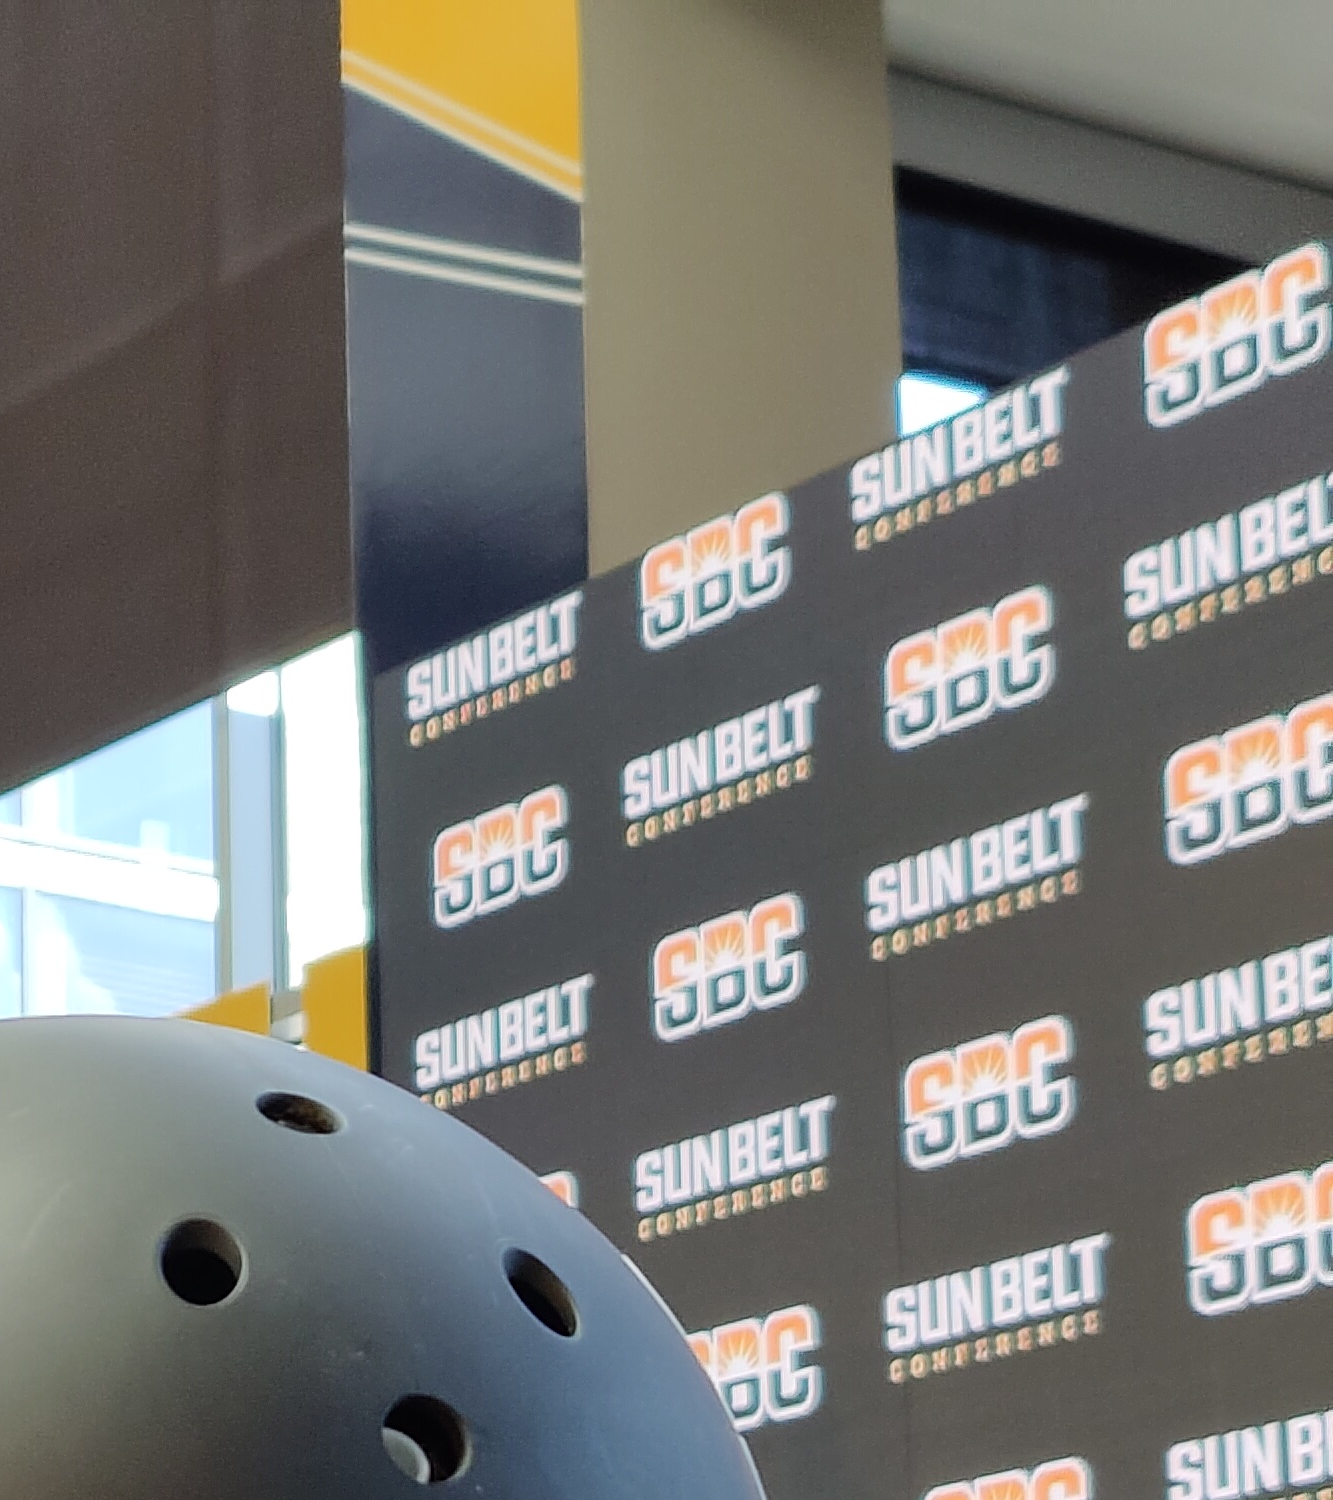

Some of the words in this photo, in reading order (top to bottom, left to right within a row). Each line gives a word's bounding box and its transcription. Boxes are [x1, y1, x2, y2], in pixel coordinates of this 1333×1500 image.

[1143, 242, 1333, 429] SBC
[852, 425, 952, 521] SUN
[950, 366, 1071, 488] BELT
[857, 443, 1059, 549] CONFERENCE
[640, 494, 787, 651] SBC
[1124, 514, 1240, 619] SUN
[1237, 472, 1333, 577] BEL
[1129, 546, 1333, 649] CONFERENC
[406, 633, 491, 721] SUN
[489, 592, 583, 695] BELT
[410, 659, 574, 747] CONFERENCE
[884, 585, 1056, 752] SBC
[622, 729, 713, 819] SUN
[711, 686, 820, 796] BELT
[627, 756, 810, 847] CONFERENCE
[434, 785, 569, 929] SBC
[865, 836, 973, 933] SUN
[971, 794, 1088, 895] BELT
[871, 870, 1078, 961] CONFERENCE
[653, 893, 806, 1043] SBC
[1144, 961, 1263, 1060] SUN
[416, 1011, 499, 1089] SUN
[497, 974, 594, 1062] BELT
[902, 1015, 1077, 1171] SBC
[636, 1129, 731, 1213] SUN
[729, 1096, 836, 1190] BELT
[639, 1167, 827, 1235] CONFERENCE
[884, 1265, 993, 1353] SUN
[991, 1233, 1111, 1321] BELT
[890, 1310, 1099, 1384] CONFERENCE
